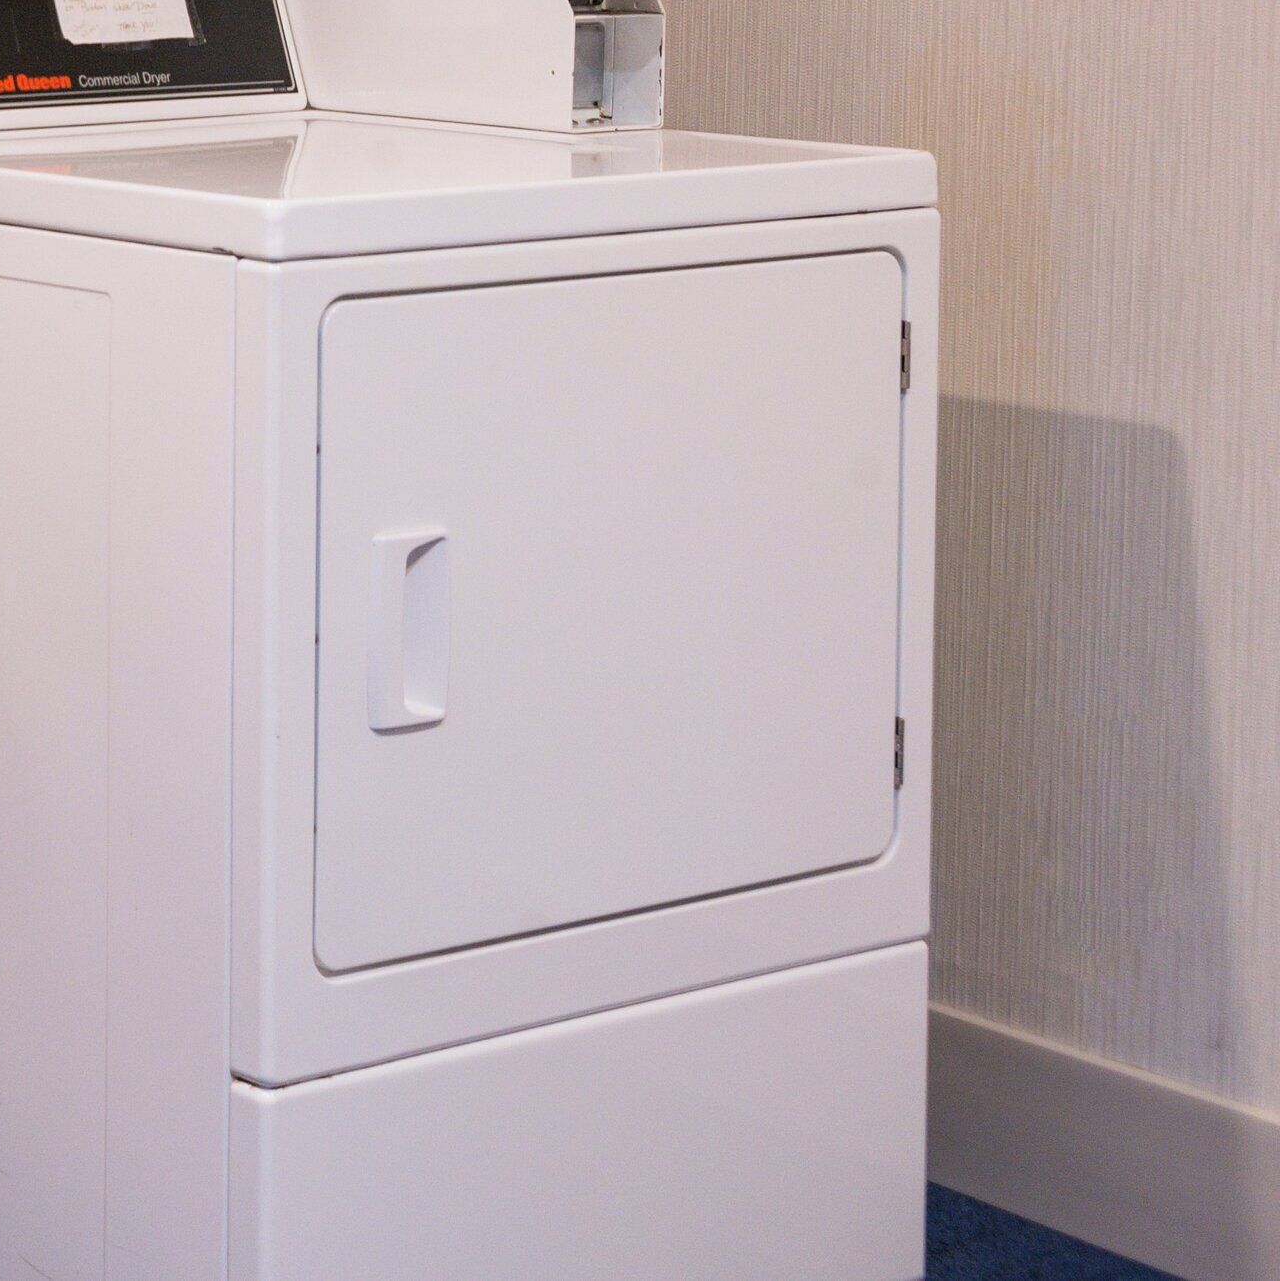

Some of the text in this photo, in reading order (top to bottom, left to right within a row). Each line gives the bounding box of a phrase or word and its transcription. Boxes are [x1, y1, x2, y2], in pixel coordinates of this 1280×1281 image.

[16, 73, 72, 91] Queen
[78, 72, 140, 88] Commercial
[142, 71, 171, 86] Dryer
